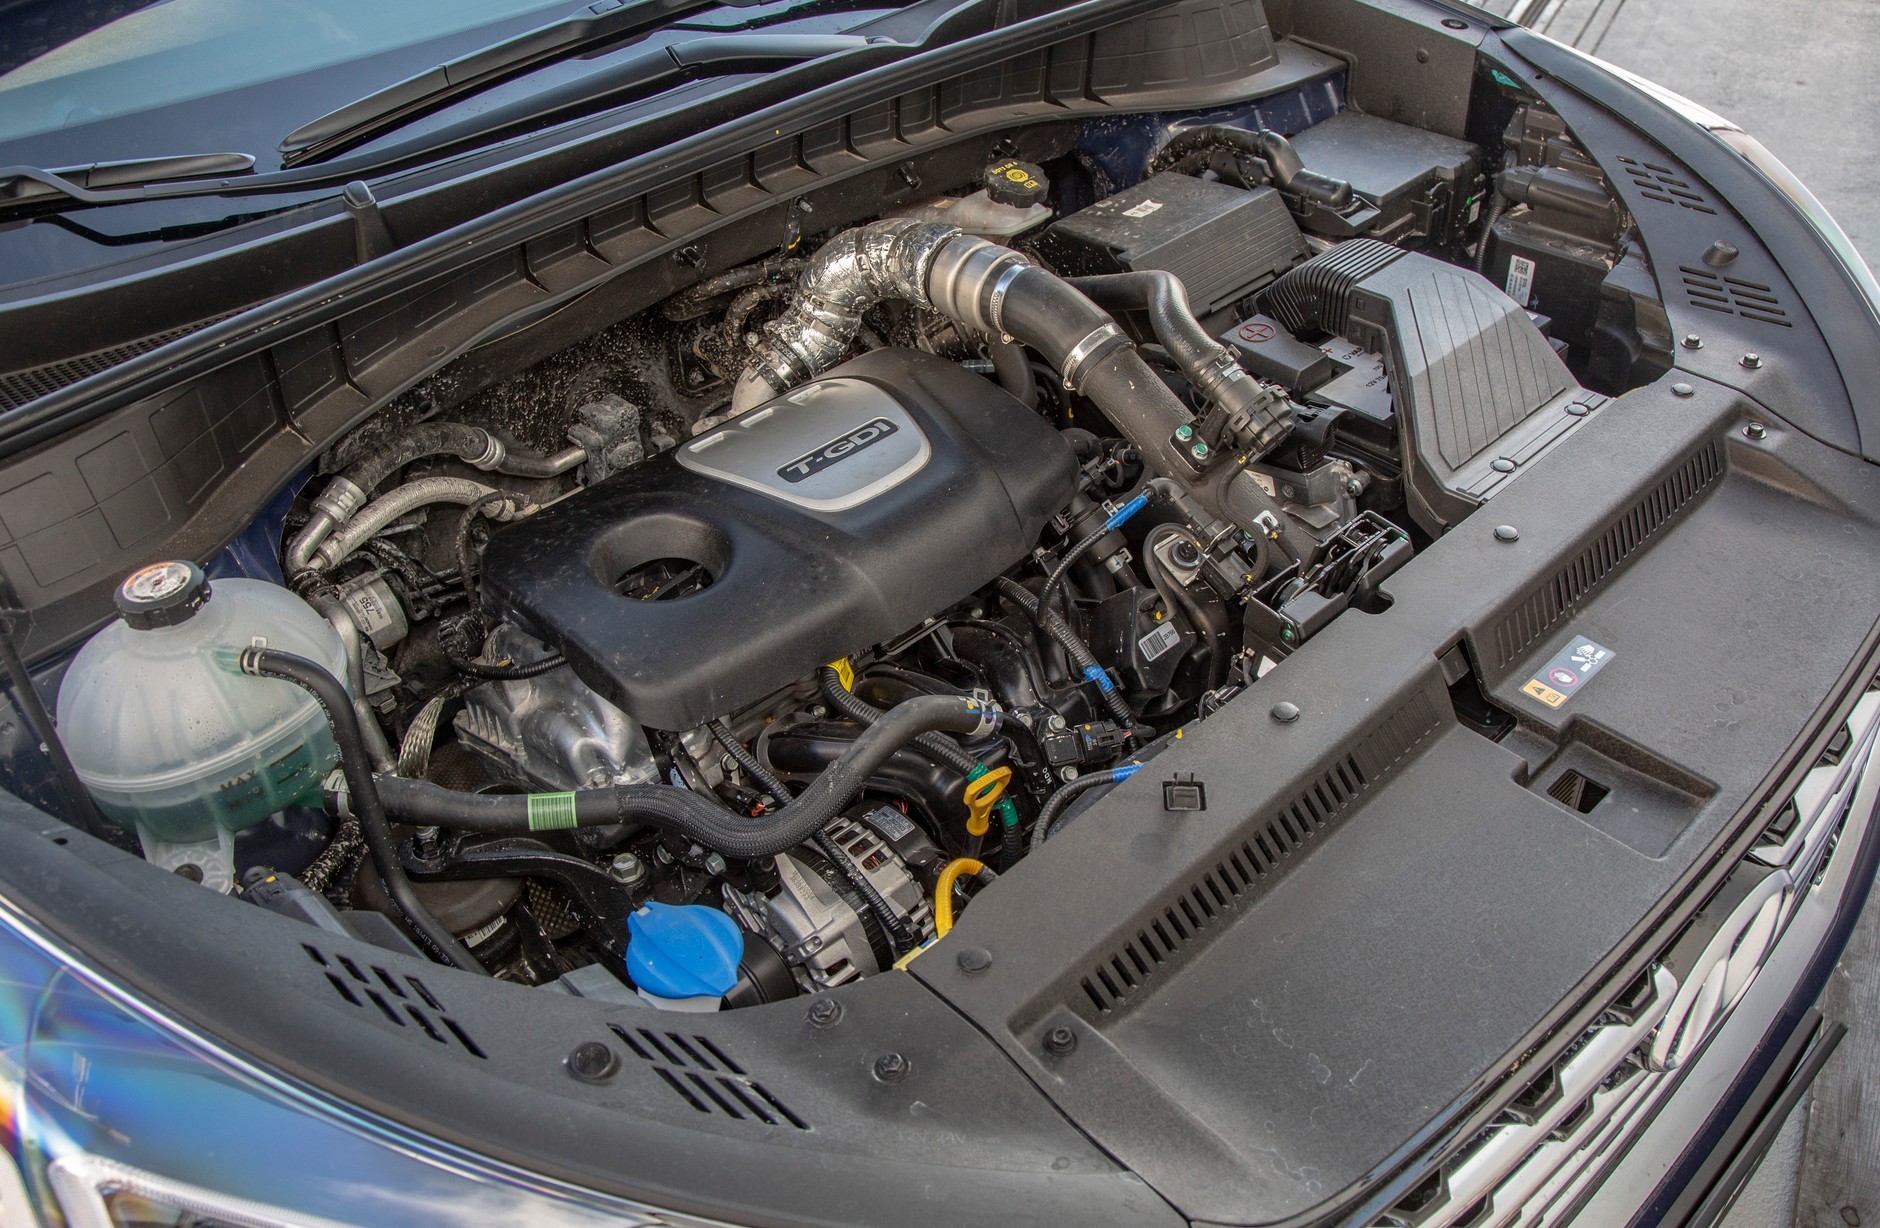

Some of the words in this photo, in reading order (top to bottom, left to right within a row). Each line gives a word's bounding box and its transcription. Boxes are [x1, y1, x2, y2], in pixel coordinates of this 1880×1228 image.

[787, 421, 891, 475] T-GDI
[360, 597, 375, 615] 755
[220, 769, 257, 791] MAX
